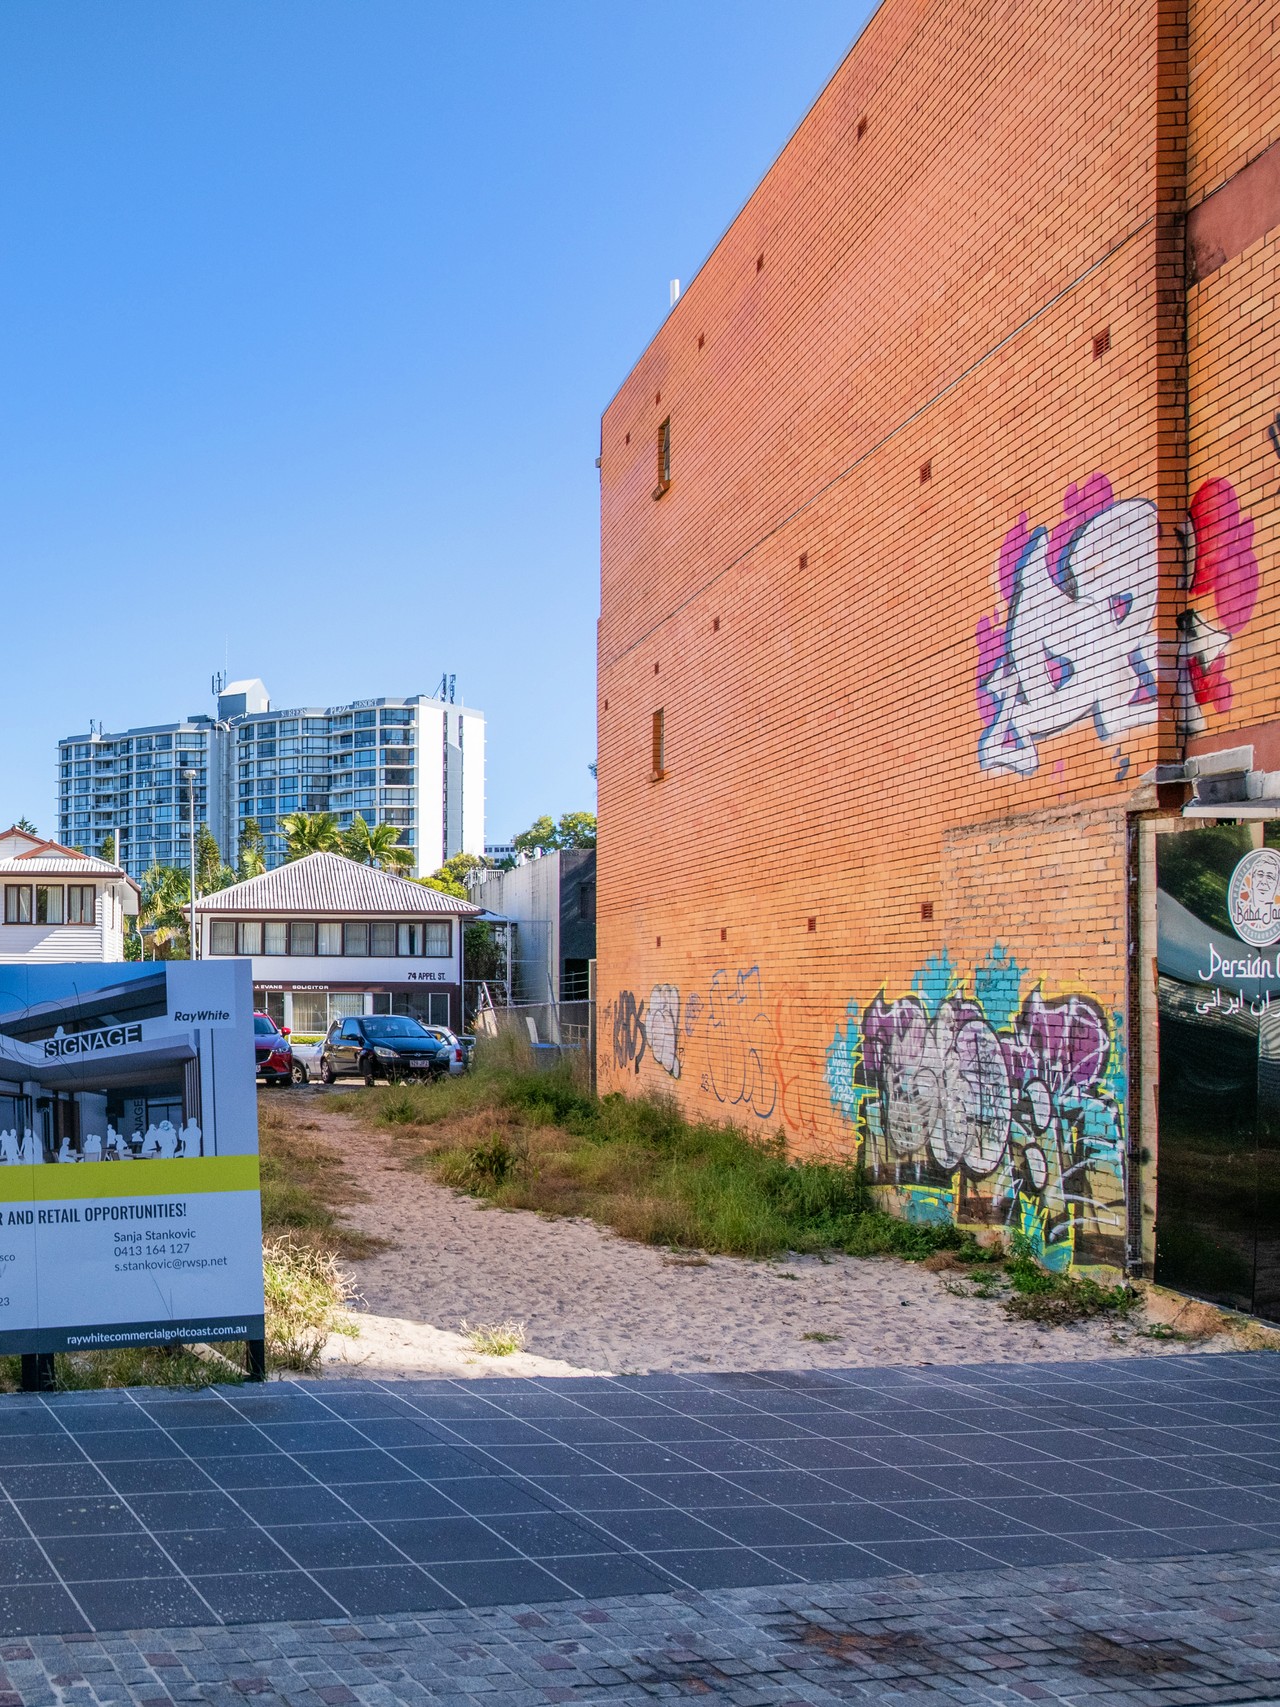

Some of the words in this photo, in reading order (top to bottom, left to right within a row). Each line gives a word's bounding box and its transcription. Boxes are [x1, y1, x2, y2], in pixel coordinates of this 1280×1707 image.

[1232, 900, 1262, 926] Baba
[1198, 943, 1275, 982] Persian
[407, 972, 417, 980] 74
[418, 972, 436, 981] APPEL
[1195, 987, 1244, 1015] ایرانی
[45, 1025, 140, 1058] SIGNAGE
[7, 1210, 34, 1225] AND
[38, 1208, 81, 1224] RETAIL
[84, 1202, 187, 1222] OPPORTUNITIES!
[114, 1231, 142, 1244] Sanja
[145, 1228, 196, 1241] Stankovic
[114, 1245, 143, 1257] 0413
[146, 1244, 166, 1256] 164
[170, 1243, 190, 1254] 127
[114, 1256, 228, 1272] s.stankovic@rwsp.net
[67, 1324, 248, 1345] raywhitecommercialgoldcoast.com.au
